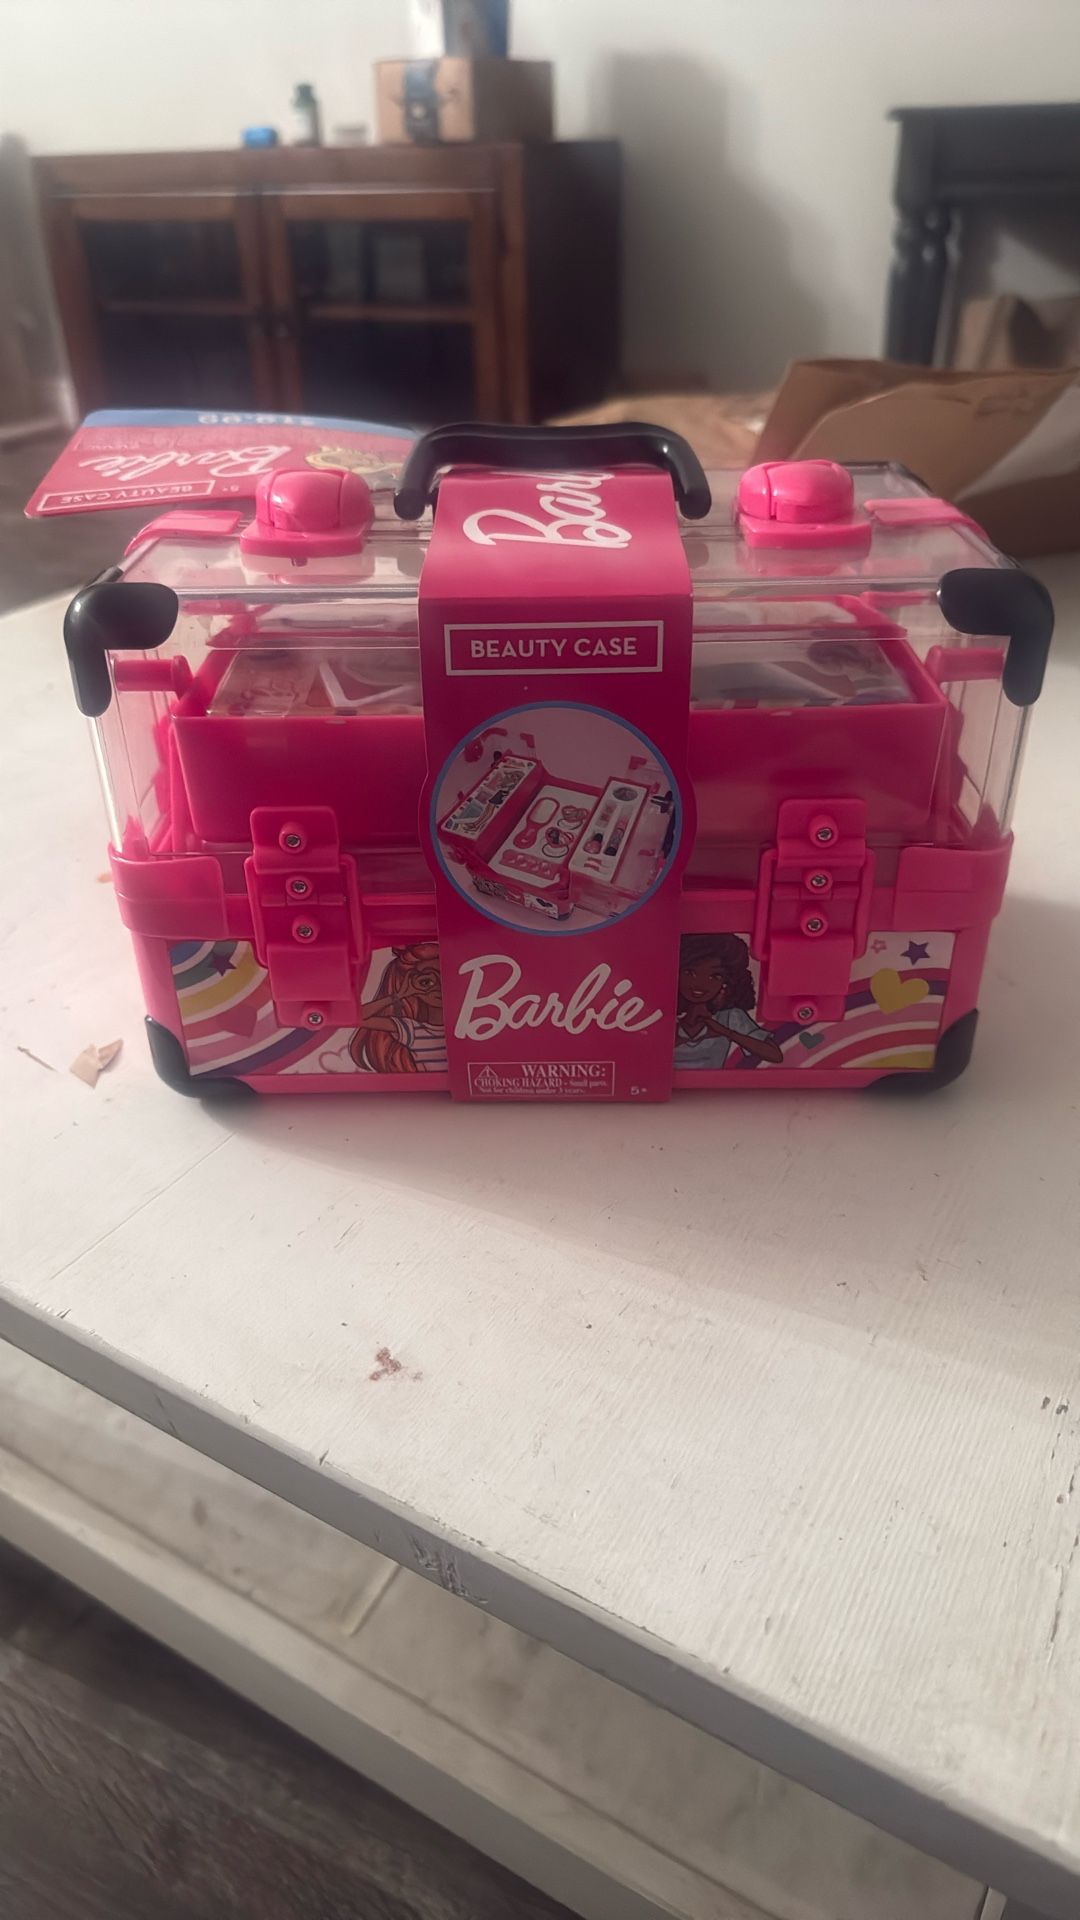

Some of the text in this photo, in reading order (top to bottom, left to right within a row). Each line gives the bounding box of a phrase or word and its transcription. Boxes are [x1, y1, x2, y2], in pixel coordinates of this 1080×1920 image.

[78, 444, 293, 481] Barbie
[60, 485, 193, 504] BEAUTY CASE
[470, 637, 637, 659] BEAUTY CASE
[454, 954, 664, 1042] Barbie
[521, 1064, 606, 1078] WARNING:
[474, 1078, 520, 1087] CHOKING
[521, 1078, 562, 1087] HAZARD
